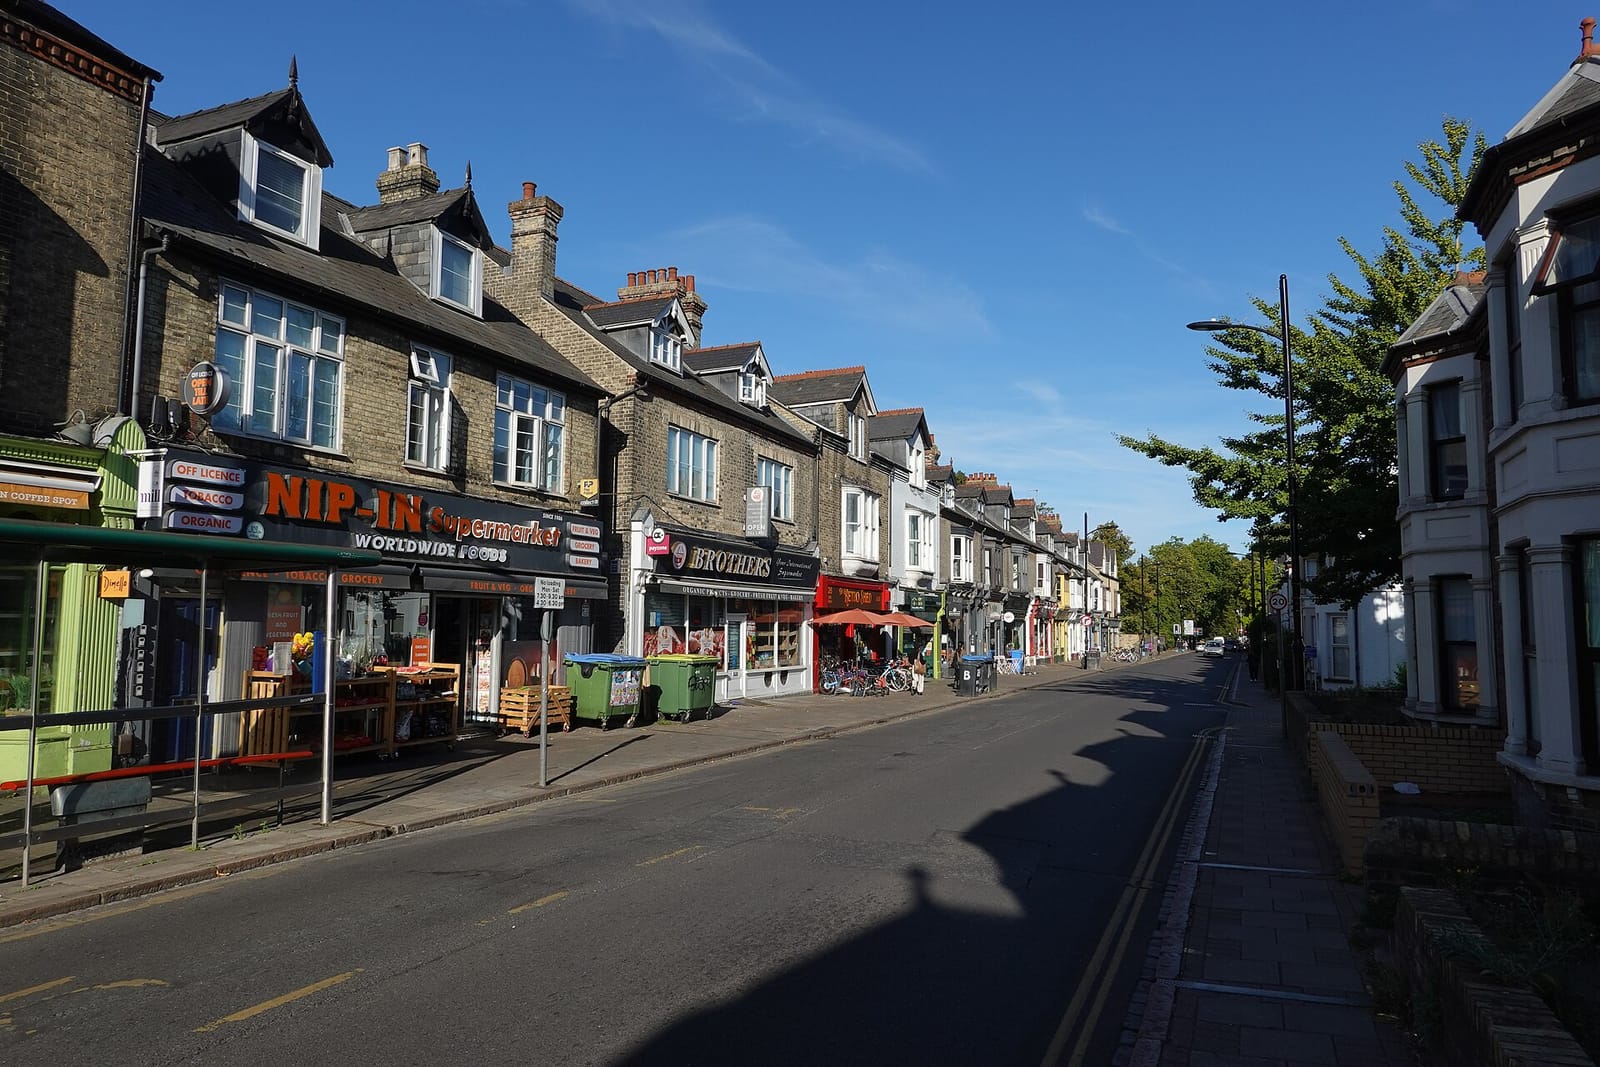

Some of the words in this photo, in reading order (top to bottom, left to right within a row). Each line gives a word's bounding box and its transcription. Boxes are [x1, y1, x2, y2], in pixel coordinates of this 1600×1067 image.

[176, 464, 198, 475] OFF
[200, 467, 240, 482] LICENCE
[11, 492, 50, 503] COFFEE
[52, 496, 78, 505] SPOT
[182, 488, 233, 505] TOBACCO
[266, 472, 423, 534] NIP-IN
[429, 506, 561, 546] Supermarket
[181, 515, 232, 529] ORGANIC
[356, 534, 456, 557] WORLDWIDE
[458, 544, 507, 562] FOODS
[691, 547, 772, 577] BROTHERS
[286, 571, 328, 581] TOBACC
[341, 574, 384, 584] GROCERY
[470, 581, 489, 590] FRUIT
[498, 583, 511, 591] VEG
[682, 586, 706, 595] ORGANIC
[964, 670, 970, 680] B
